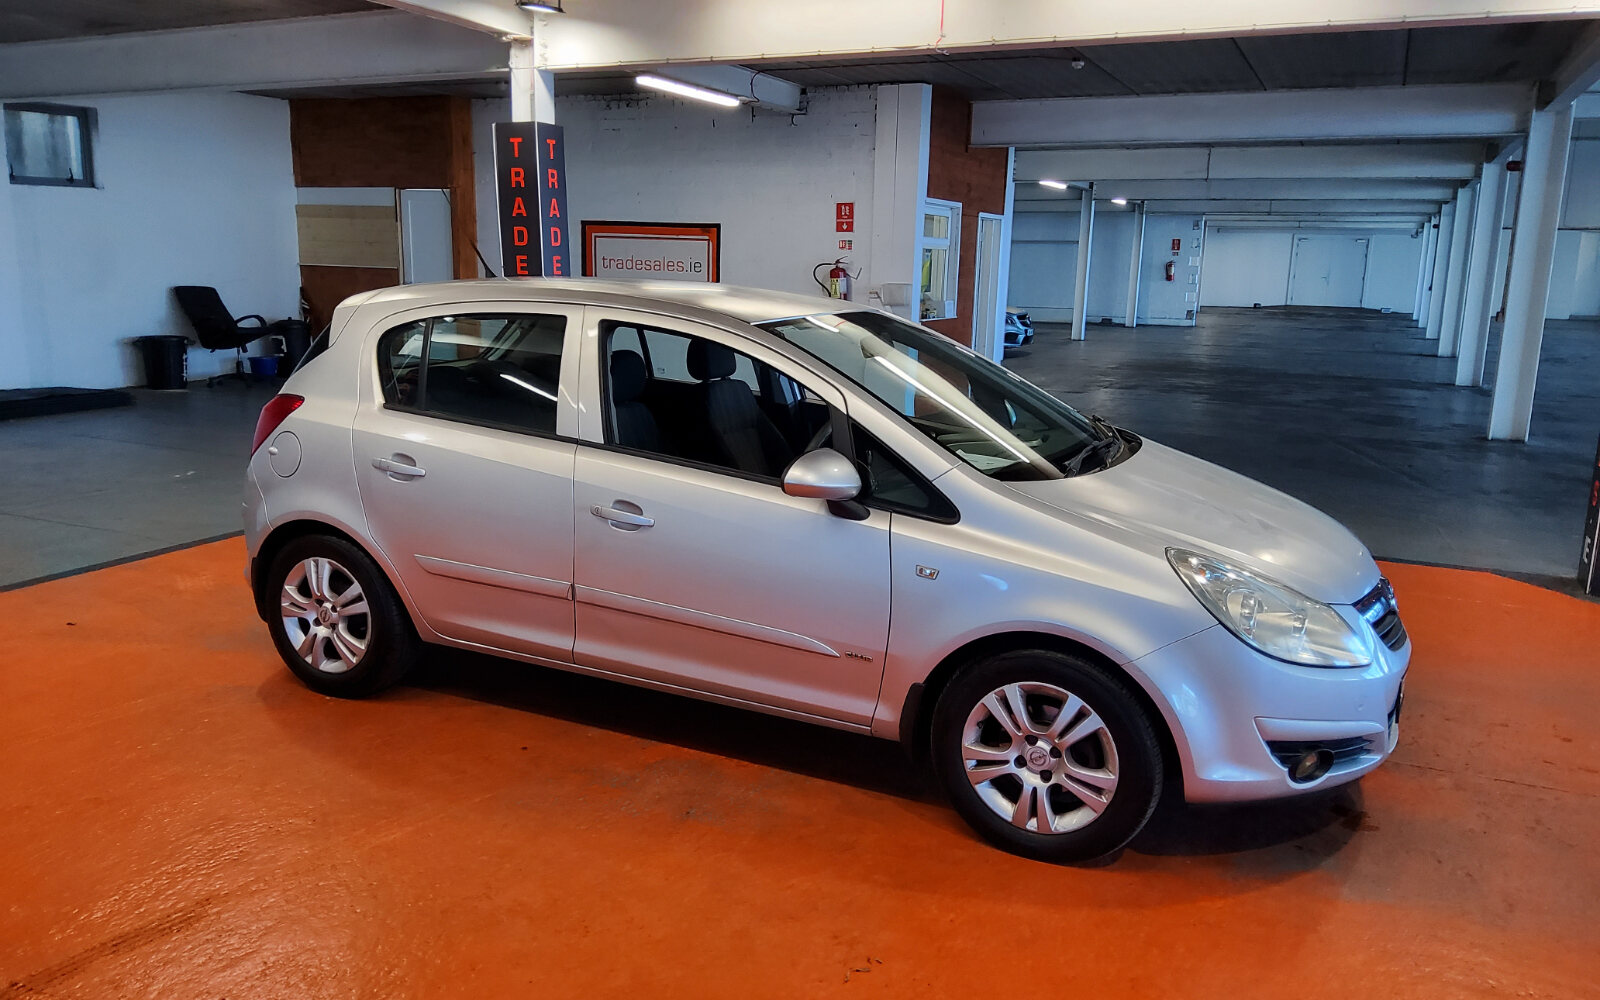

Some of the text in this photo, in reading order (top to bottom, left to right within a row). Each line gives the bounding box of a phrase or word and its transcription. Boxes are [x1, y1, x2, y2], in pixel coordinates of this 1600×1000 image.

[509, 137, 529, 275] TRADE
[546, 138, 562, 275] TRADE
[602, 254, 702, 273] tradesales.ie
